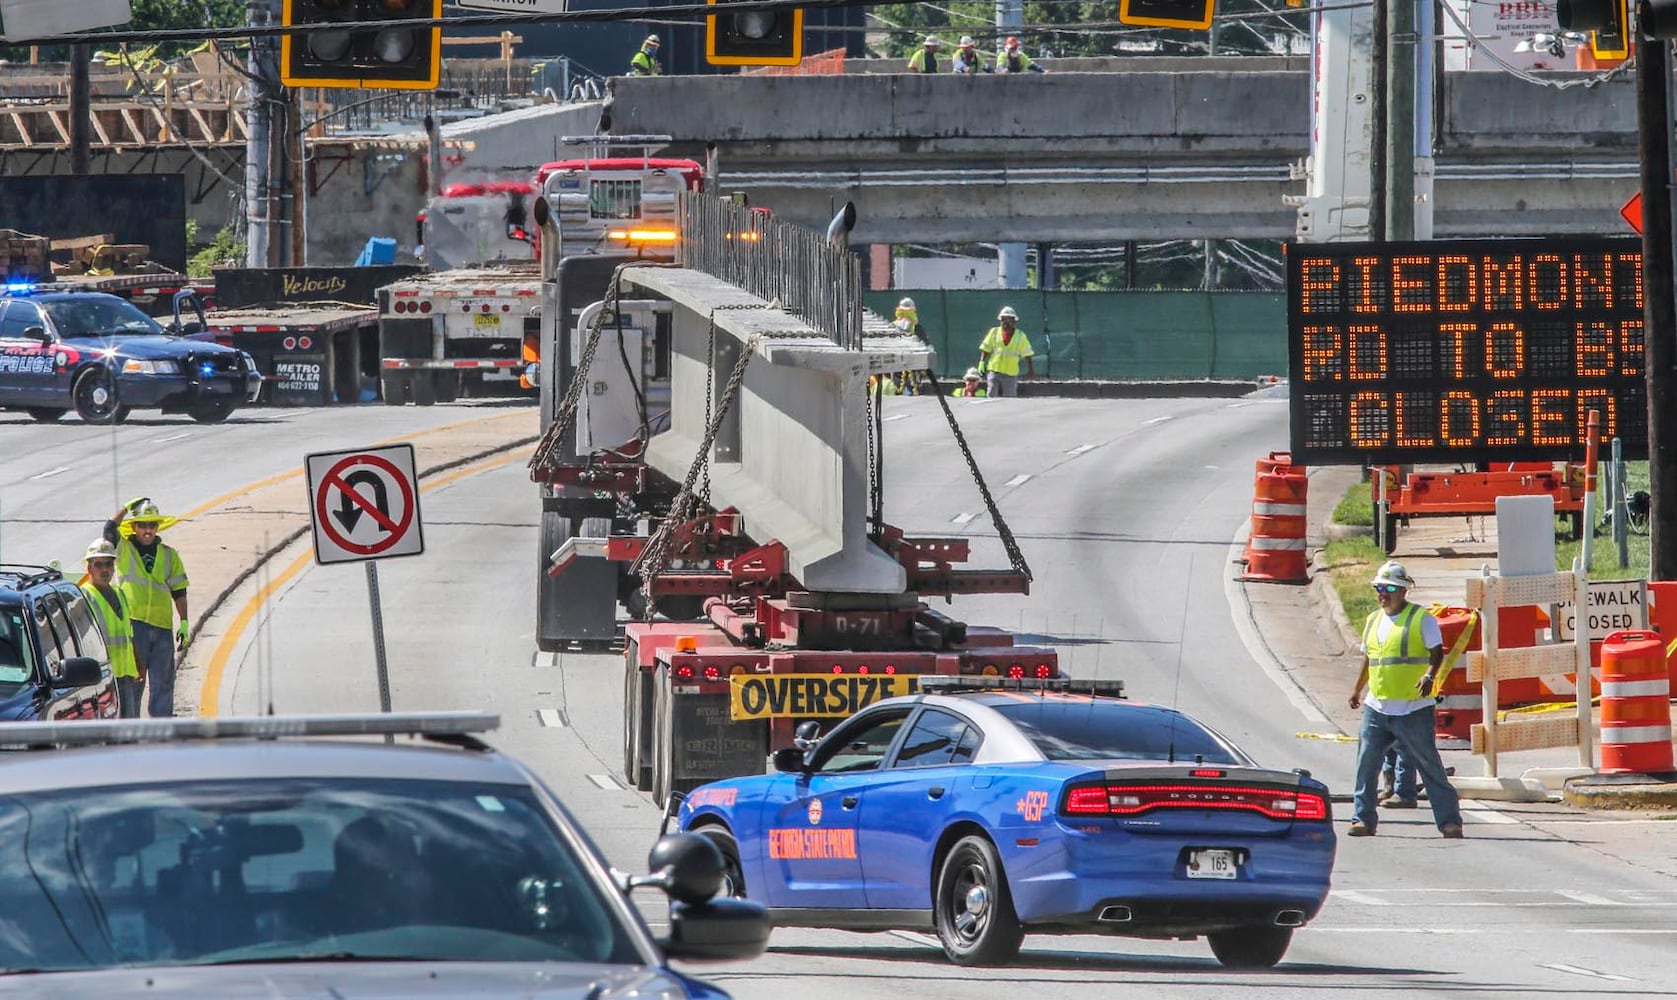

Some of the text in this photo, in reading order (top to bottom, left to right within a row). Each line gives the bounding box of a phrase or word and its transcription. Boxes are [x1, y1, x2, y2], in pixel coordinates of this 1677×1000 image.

[282, 274, 346, 296] Velocity
[1303, 324, 1387, 381] RD
[1440, 322, 1524, 379] TO
[0, 355, 54, 373] POLICE
[276, 364, 320, 374] METRO
[1350, 389, 1617, 448] CLOSED
[1567, 614, 1632, 630] COSED
[741, 677, 895, 715] OVERSIZE
[1170, 793, 1245, 801] DODGE
[1211, 856, 1228, 872] 165
